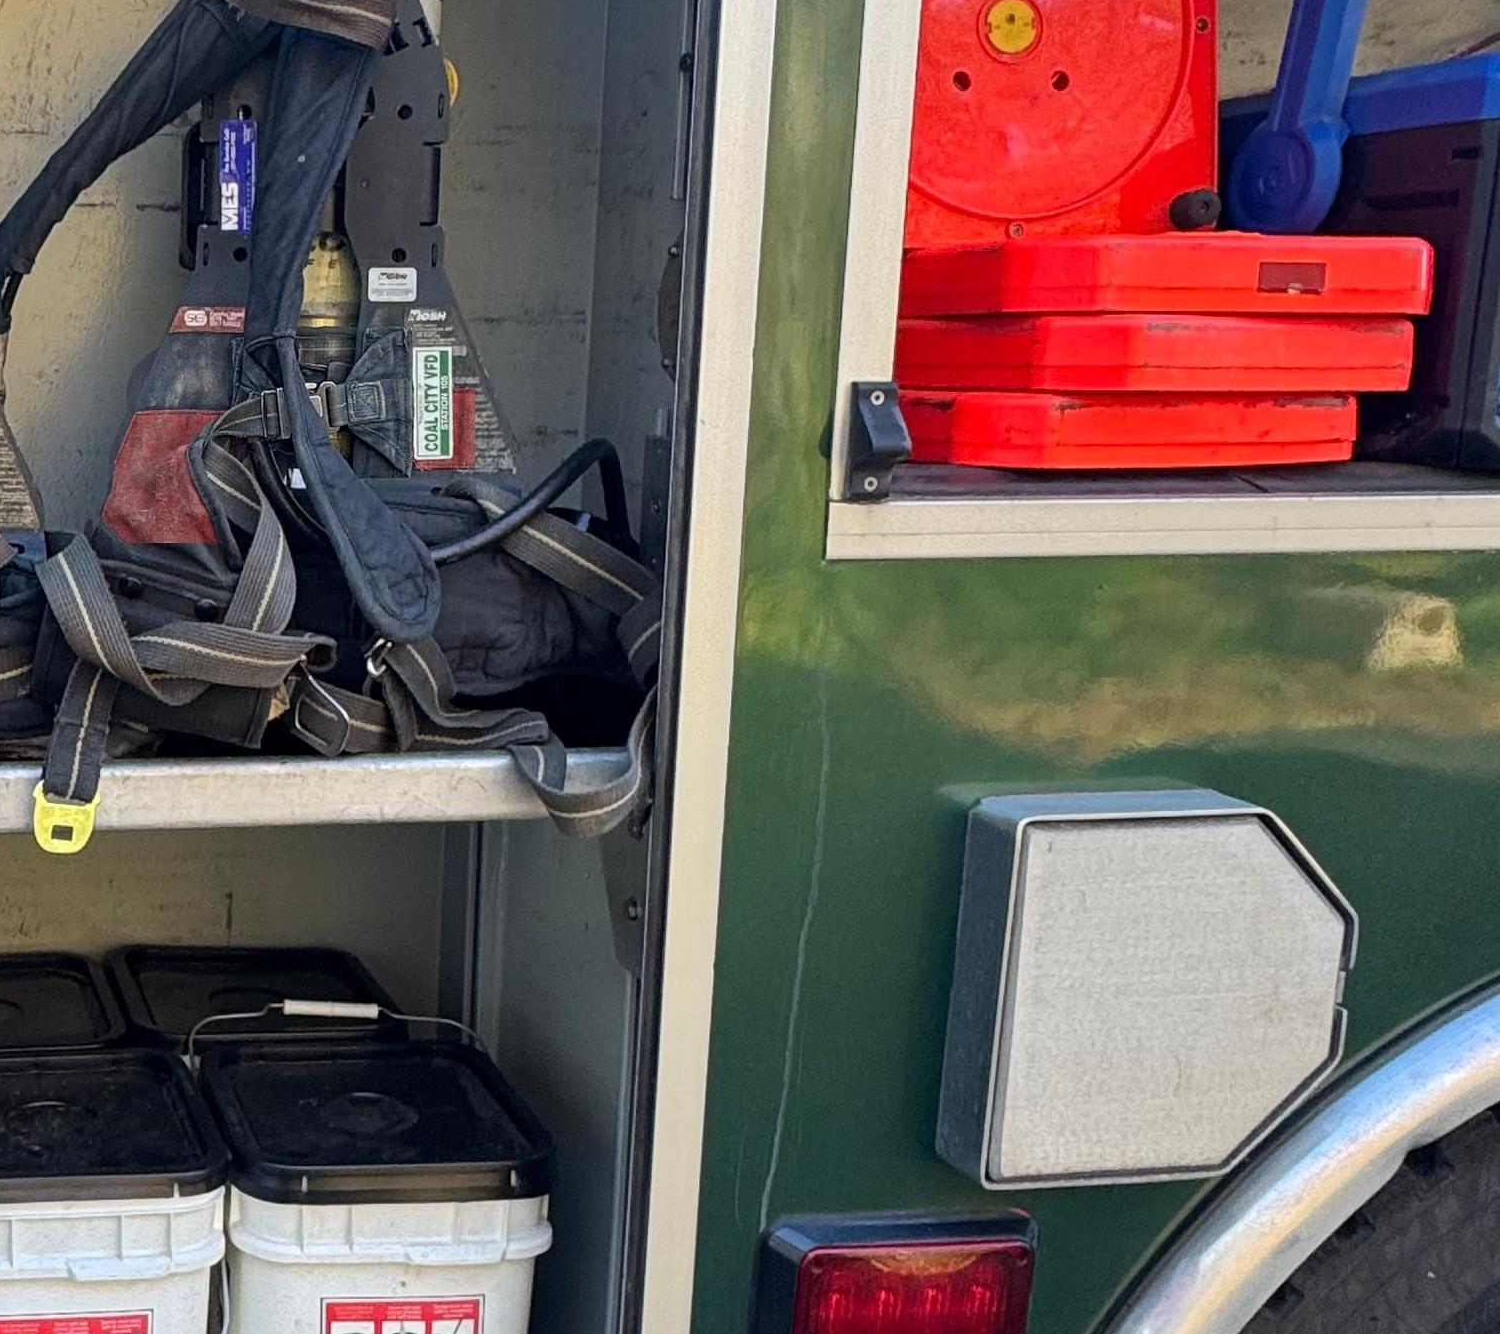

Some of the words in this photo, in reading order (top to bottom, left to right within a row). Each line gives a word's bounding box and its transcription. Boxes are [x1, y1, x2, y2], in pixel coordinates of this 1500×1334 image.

[221, 182, 238, 231] MES
[423, 354, 438, 381] VFD
[423, 383, 438, 414] CITY
[440, 392, 449, 431] STATION
[423, 417, 439, 452] COAL
